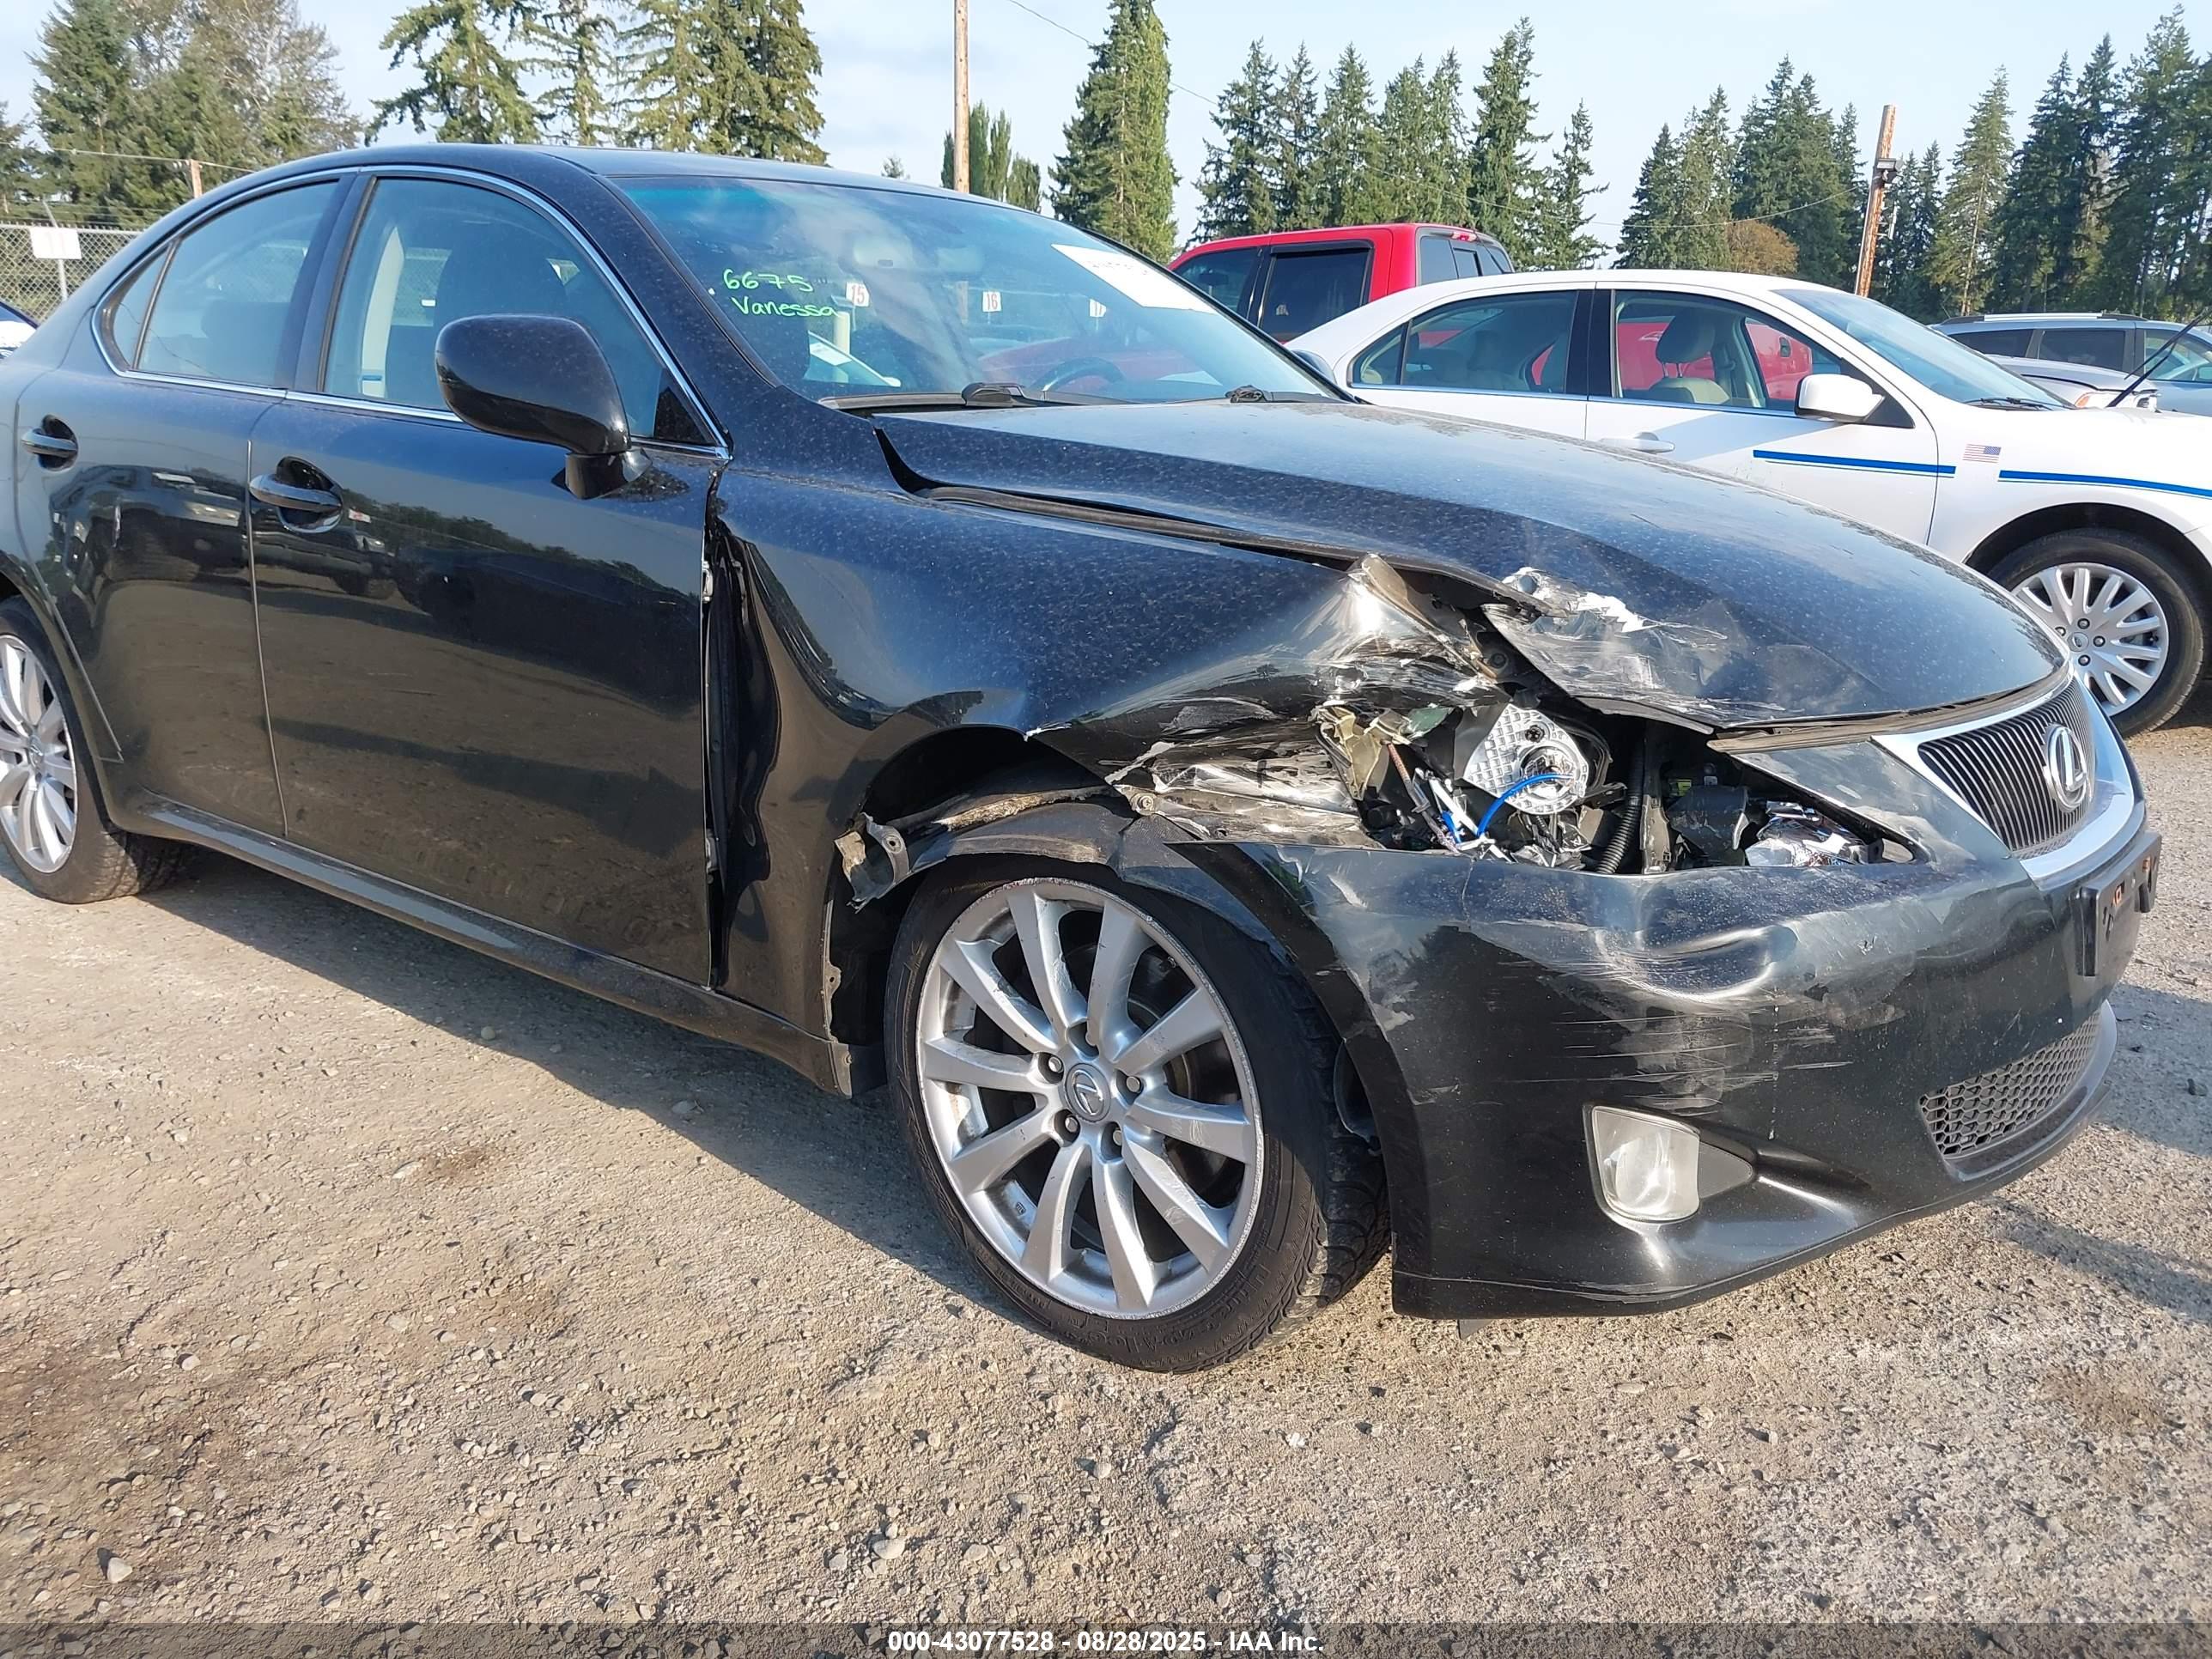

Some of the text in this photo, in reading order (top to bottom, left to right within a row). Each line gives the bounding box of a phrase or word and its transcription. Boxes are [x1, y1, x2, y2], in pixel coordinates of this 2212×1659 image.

[723, 269, 814, 293] 6675
[851, 284, 866, 304] 15
[987, 293, 999, 310] 16
[732, 296, 840, 318] Vanessa
